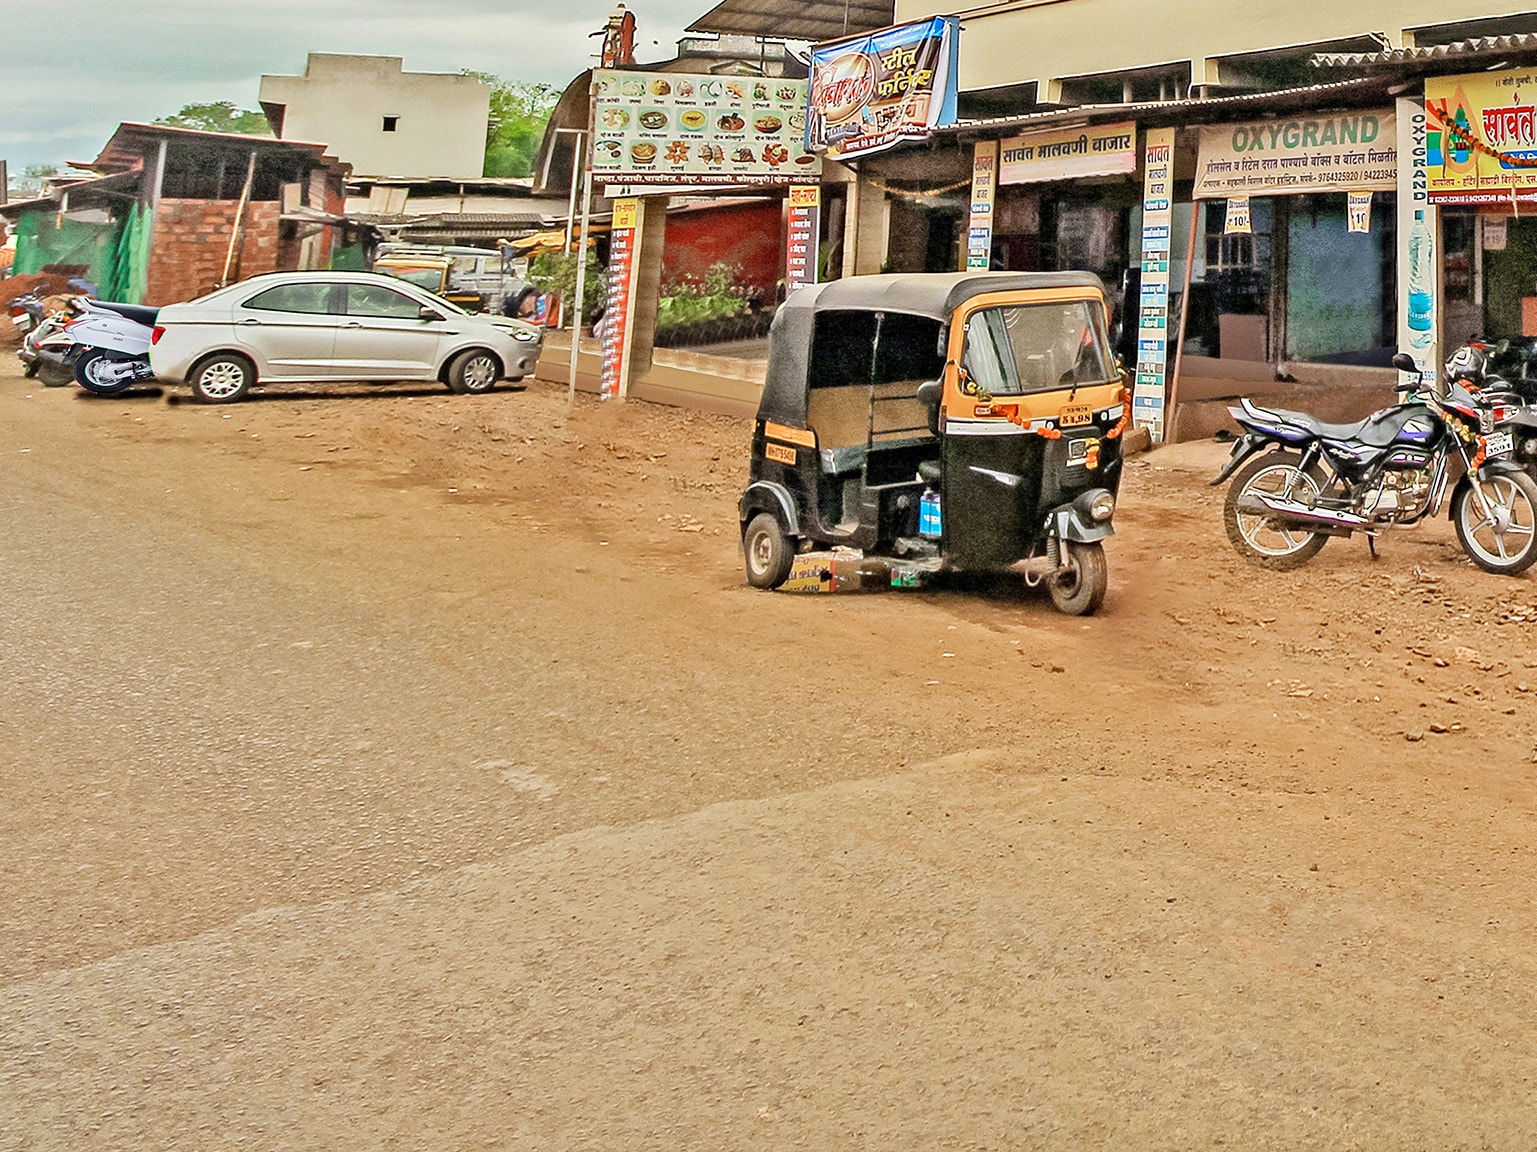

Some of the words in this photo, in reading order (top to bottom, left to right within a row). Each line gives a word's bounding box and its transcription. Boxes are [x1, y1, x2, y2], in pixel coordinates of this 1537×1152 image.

[881, 46, 918, 73] स्टील
[1482, 92, 1536, 145] सावंत
[1038, 134, 1088, 158] मालवणी
[1092, 134, 1132, 152] बाजार
[1232, 115, 1379, 153] OXYGRAND
[1242, 157, 1260, 171] रिटेल
[1261, 158, 1278, 170] दरात
[1280, 152, 1308, 168] पाण्याचे
[1334, 155, 1340, 165] व
[1412, 114, 1426, 201] OXYGRAND
[1318, 171, 1359, 182] 9764325920
